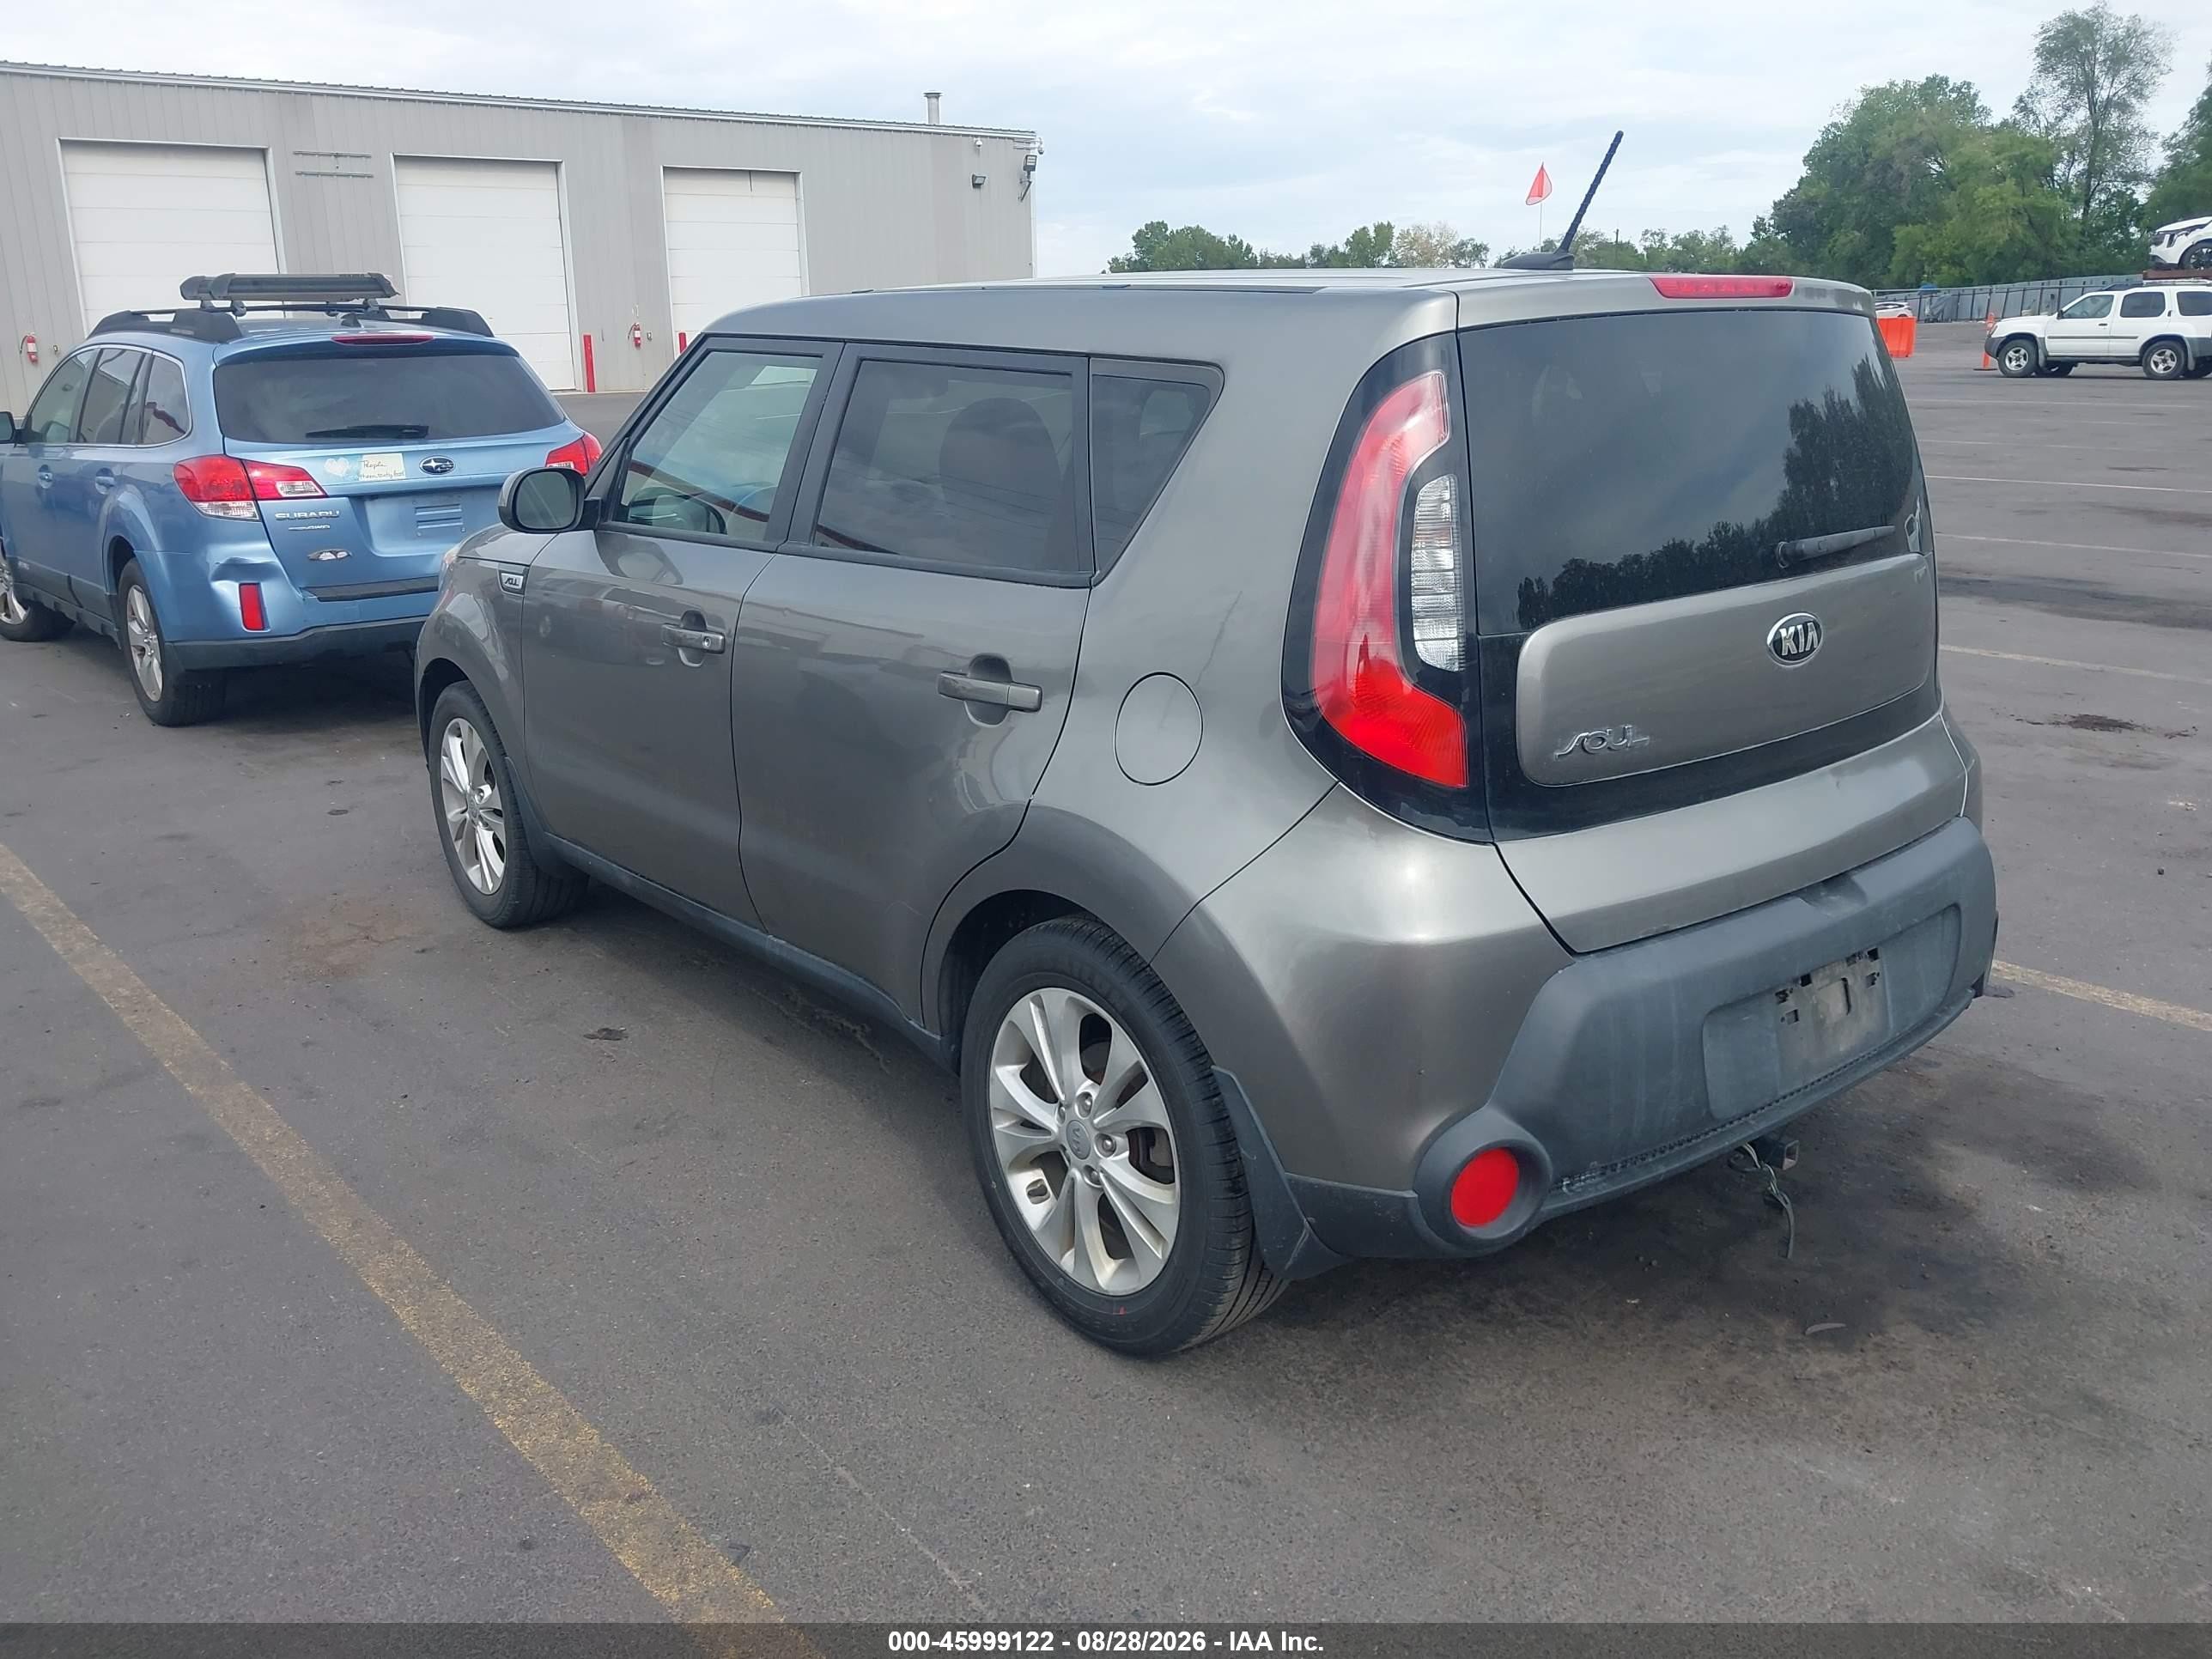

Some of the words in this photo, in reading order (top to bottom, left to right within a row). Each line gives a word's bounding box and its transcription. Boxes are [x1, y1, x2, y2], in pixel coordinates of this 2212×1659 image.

[275, 510, 340, 520] SUBARU
[1778, 621, 1820, 657] KIA
[1553, 725, 1650, 760] SOUL
